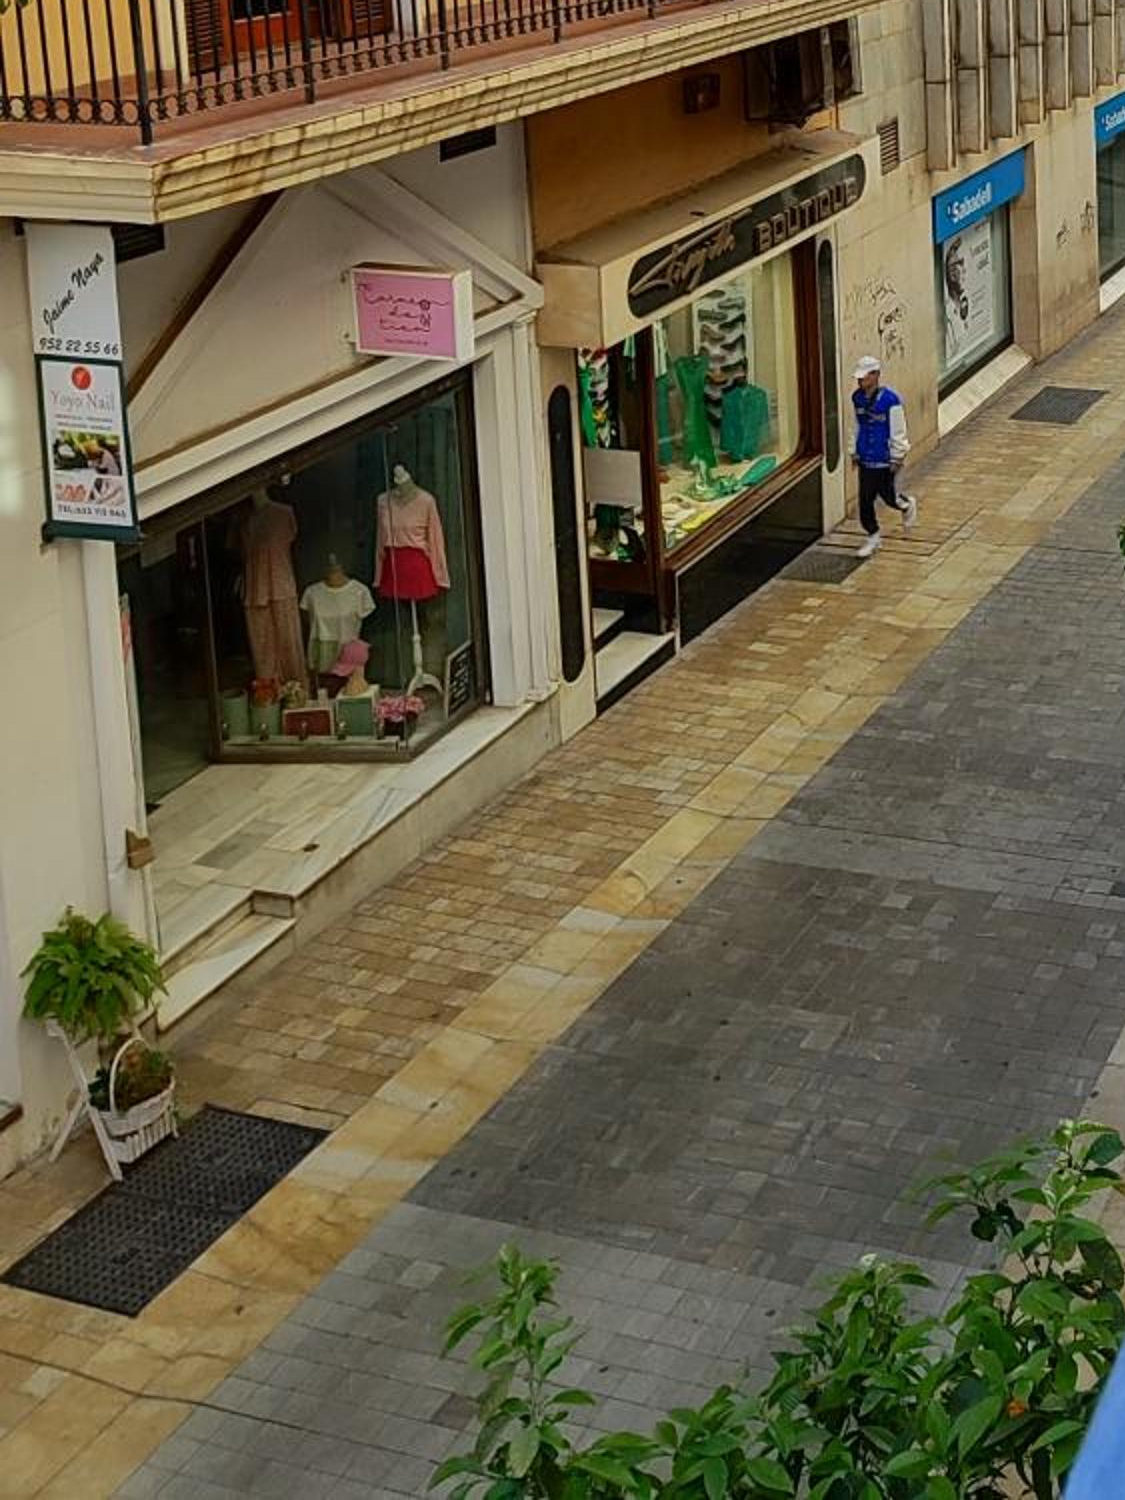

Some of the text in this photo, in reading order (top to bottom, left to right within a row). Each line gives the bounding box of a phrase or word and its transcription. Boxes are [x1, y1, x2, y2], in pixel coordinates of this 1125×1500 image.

[755, 177, 860, 252] BOUTIQUE
[42, 289, 75, 334] Jaime
[39, 337, 119, 355] 952 22 55 66
